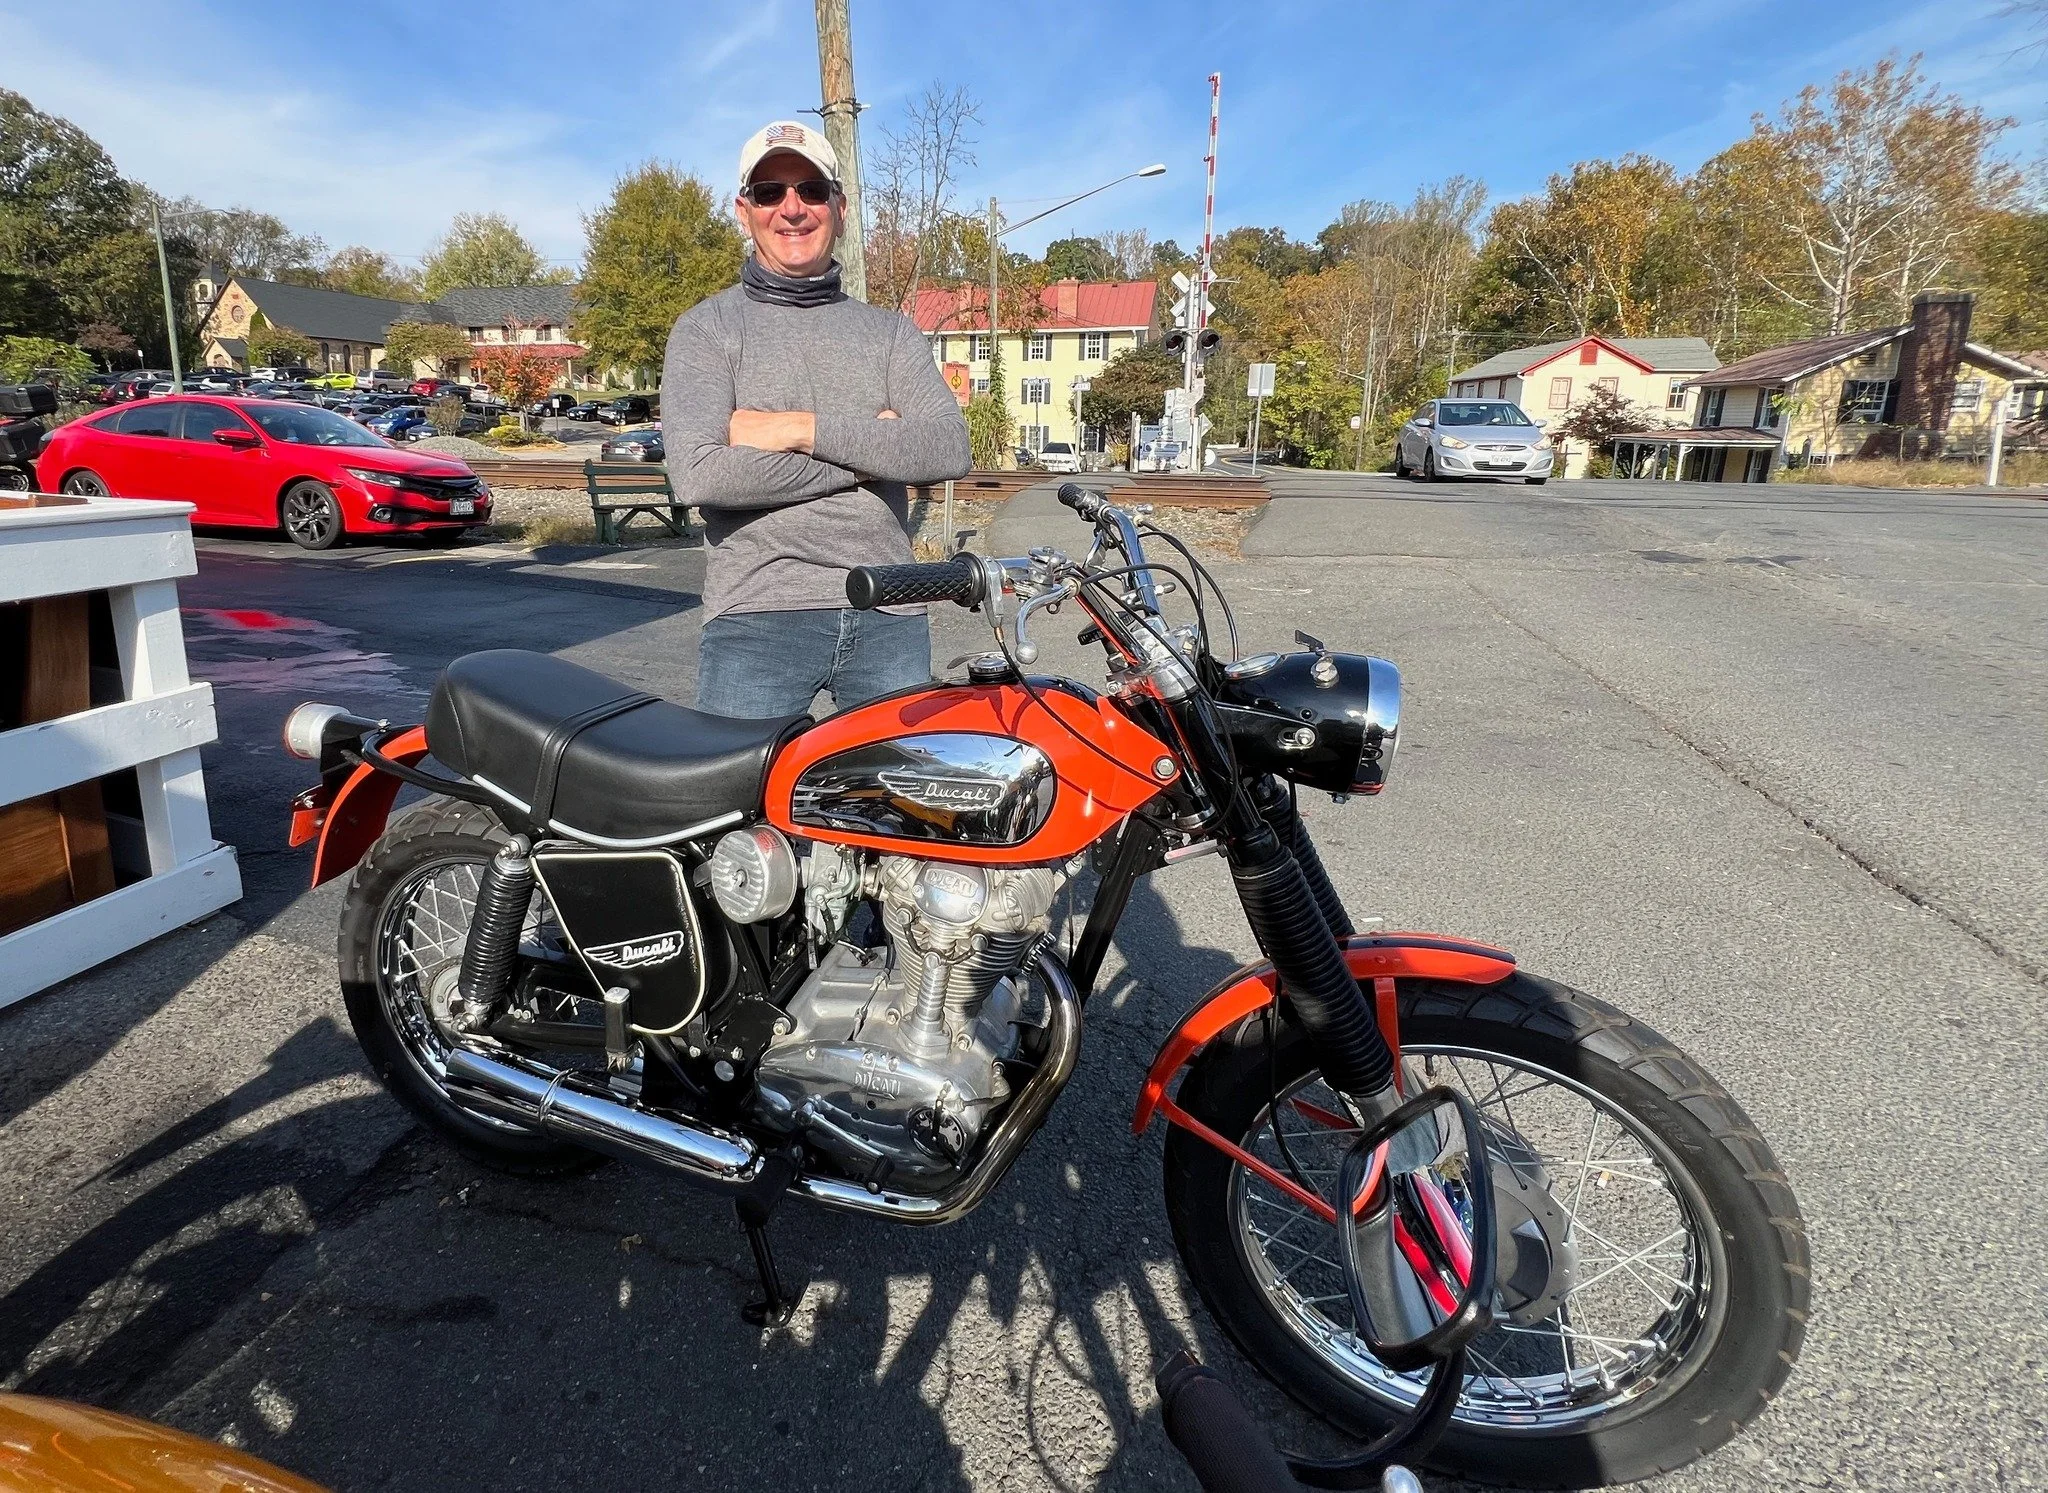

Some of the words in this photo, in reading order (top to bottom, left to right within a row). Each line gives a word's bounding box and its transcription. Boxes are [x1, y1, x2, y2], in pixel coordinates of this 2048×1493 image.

[924, 782, 990, 801] Ducati
[622, 936, 676, 961] Ducati
[855, 1071, 901, 1096] DUCATI
